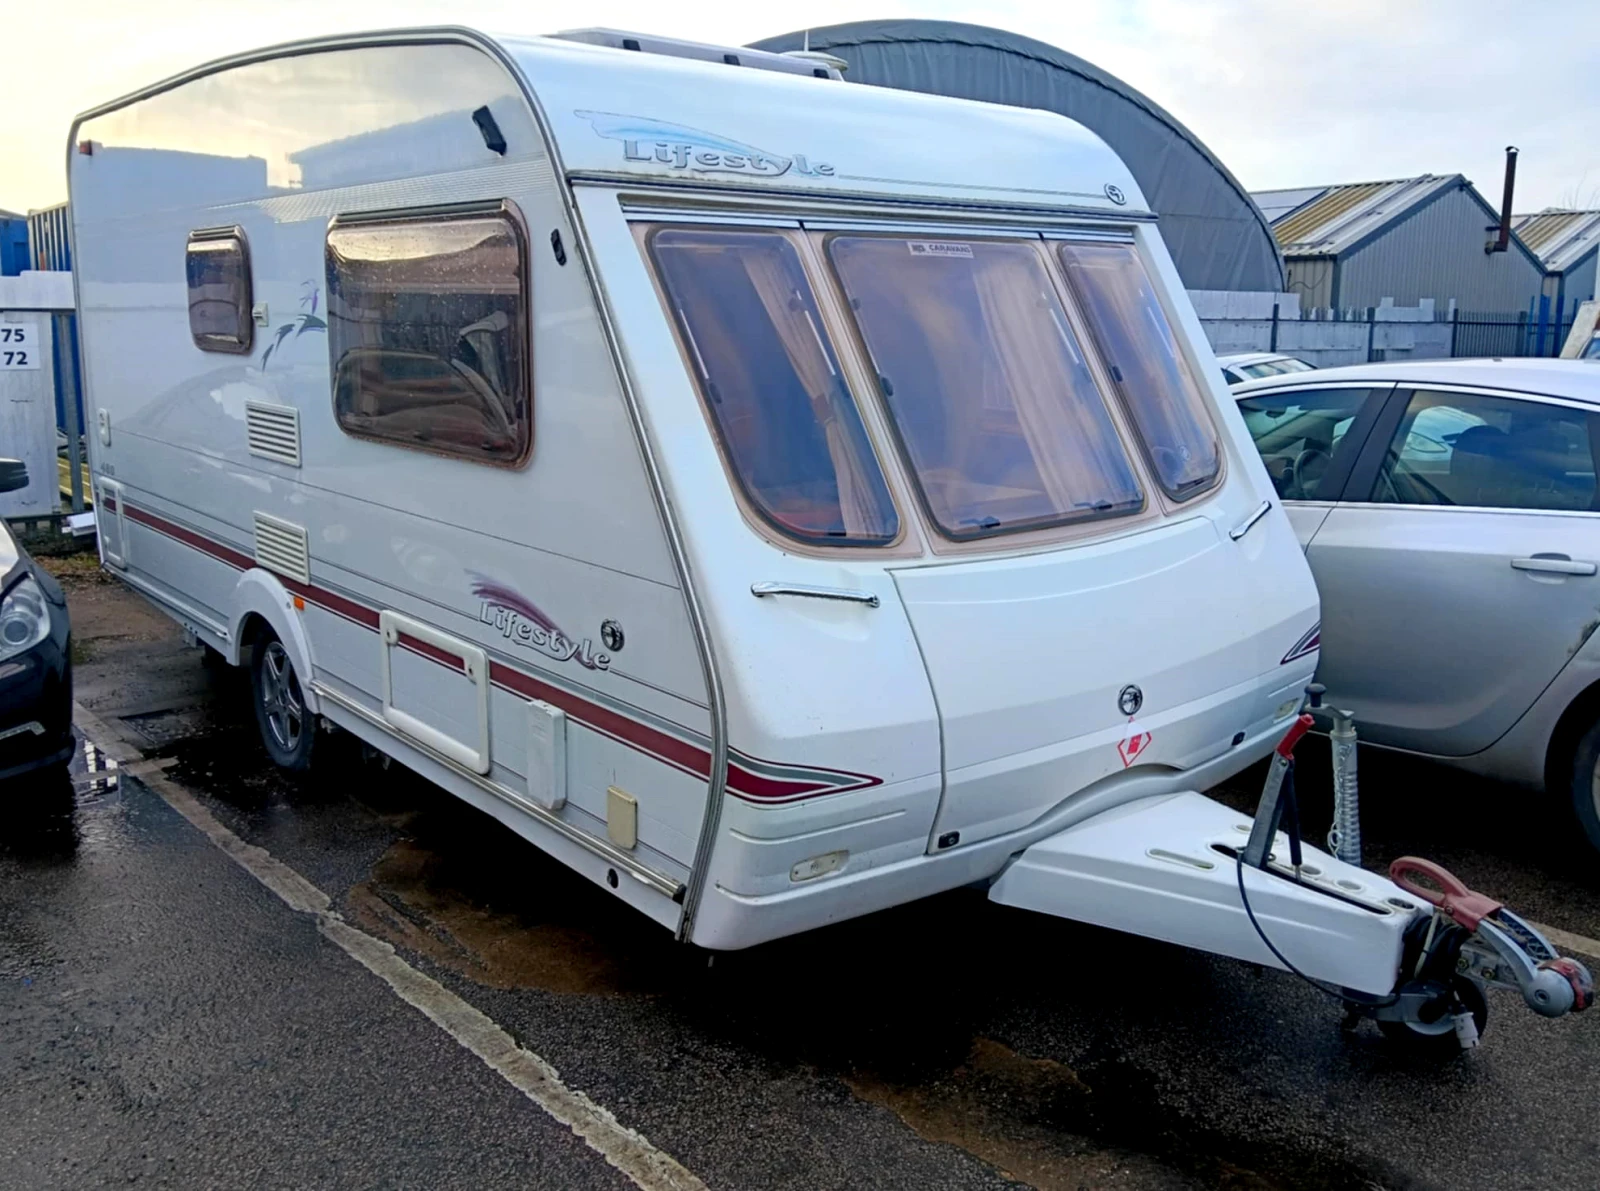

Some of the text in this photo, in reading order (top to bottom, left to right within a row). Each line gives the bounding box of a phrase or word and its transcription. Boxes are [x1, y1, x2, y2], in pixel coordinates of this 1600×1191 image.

[622, 139, 836, 177] Lifestyle
[1, 328, 26, 343] 75
[3, 351, 28, 366] 72
[479, 601, 612, 672] Lifestyle
